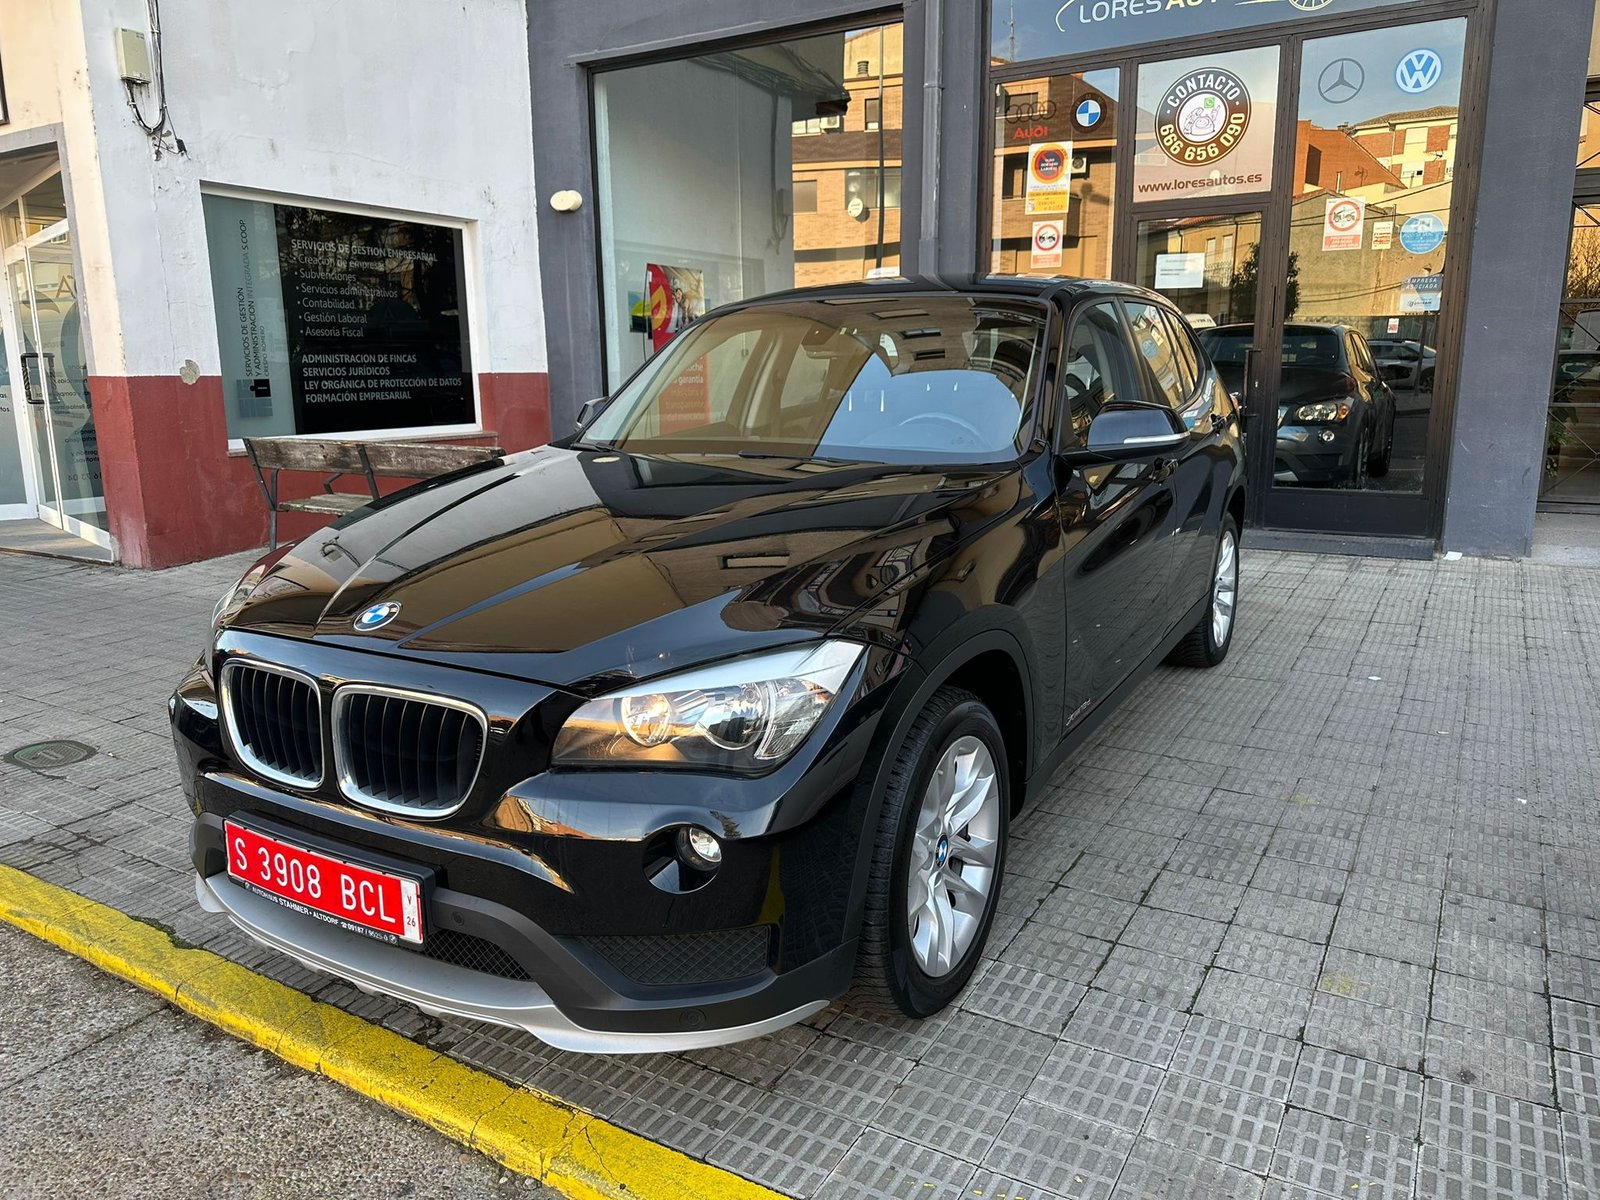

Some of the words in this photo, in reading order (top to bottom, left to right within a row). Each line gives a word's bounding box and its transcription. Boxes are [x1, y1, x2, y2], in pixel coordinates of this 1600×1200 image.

[1167, 74, 1240, 107] CONTACTO
[1160, 124, 1184, 154] 666
[1184, 143, 1219, 160] 656
[1220, 113, 1245, 147] 090
[1138, 174, 1262, 193] www.loresautos.es
[290, 239, 337, 252] SERVICIOS
[338, 244, 350, 254] DE
[388, 249, 438, 262] EMPRESARIAL
[243, 252, 255, 298] INTEGRADA
[300, 268, 357, 282] Subvenciones
[301, 284, 338, 295] Servicios
[340, 286, 398, 298] administrativos
[303, 312, 336, 323] Gestión
[338, 313, 367, 324] Laboral
[241, 324, 248, 335] DE
[342, 327, 364, 337] Fiscal
[241, 337, 254, 377] SERVICIOS
[378, 354, 389, 363] DE
[390, 354, 417, 363] FINCAS
[303, 367, 347, 377] SERVICIOS
[348, 364, 390, 376] JURÍDICOS
[304, 381, 319, 390] LEY
[321, 378, 366, 390] ORGÁNICA
[368, 380, 379, 388] DE
[380, 377, 426, 388] PROTECCIÓN
[428, 378, 439, 387] DE
[439, 378, 462, 387] DATOS
[305, 391, 357, 403] FORMACIÓN
[359, 391, 412, 402] EMPRESARIAL
[234, 837, 249, 872] S
[257, 846, 322, 900] 3908
[339, 873, 397, 924] BCL
[251, 886, 279, 903] AUTOHAUS
[278, 897, 309, 916] STAHMER
[312, 911, 340, 925] ALTDORF
[406, 895, 412, 905] V
[406, 916, 416, 927] 26
